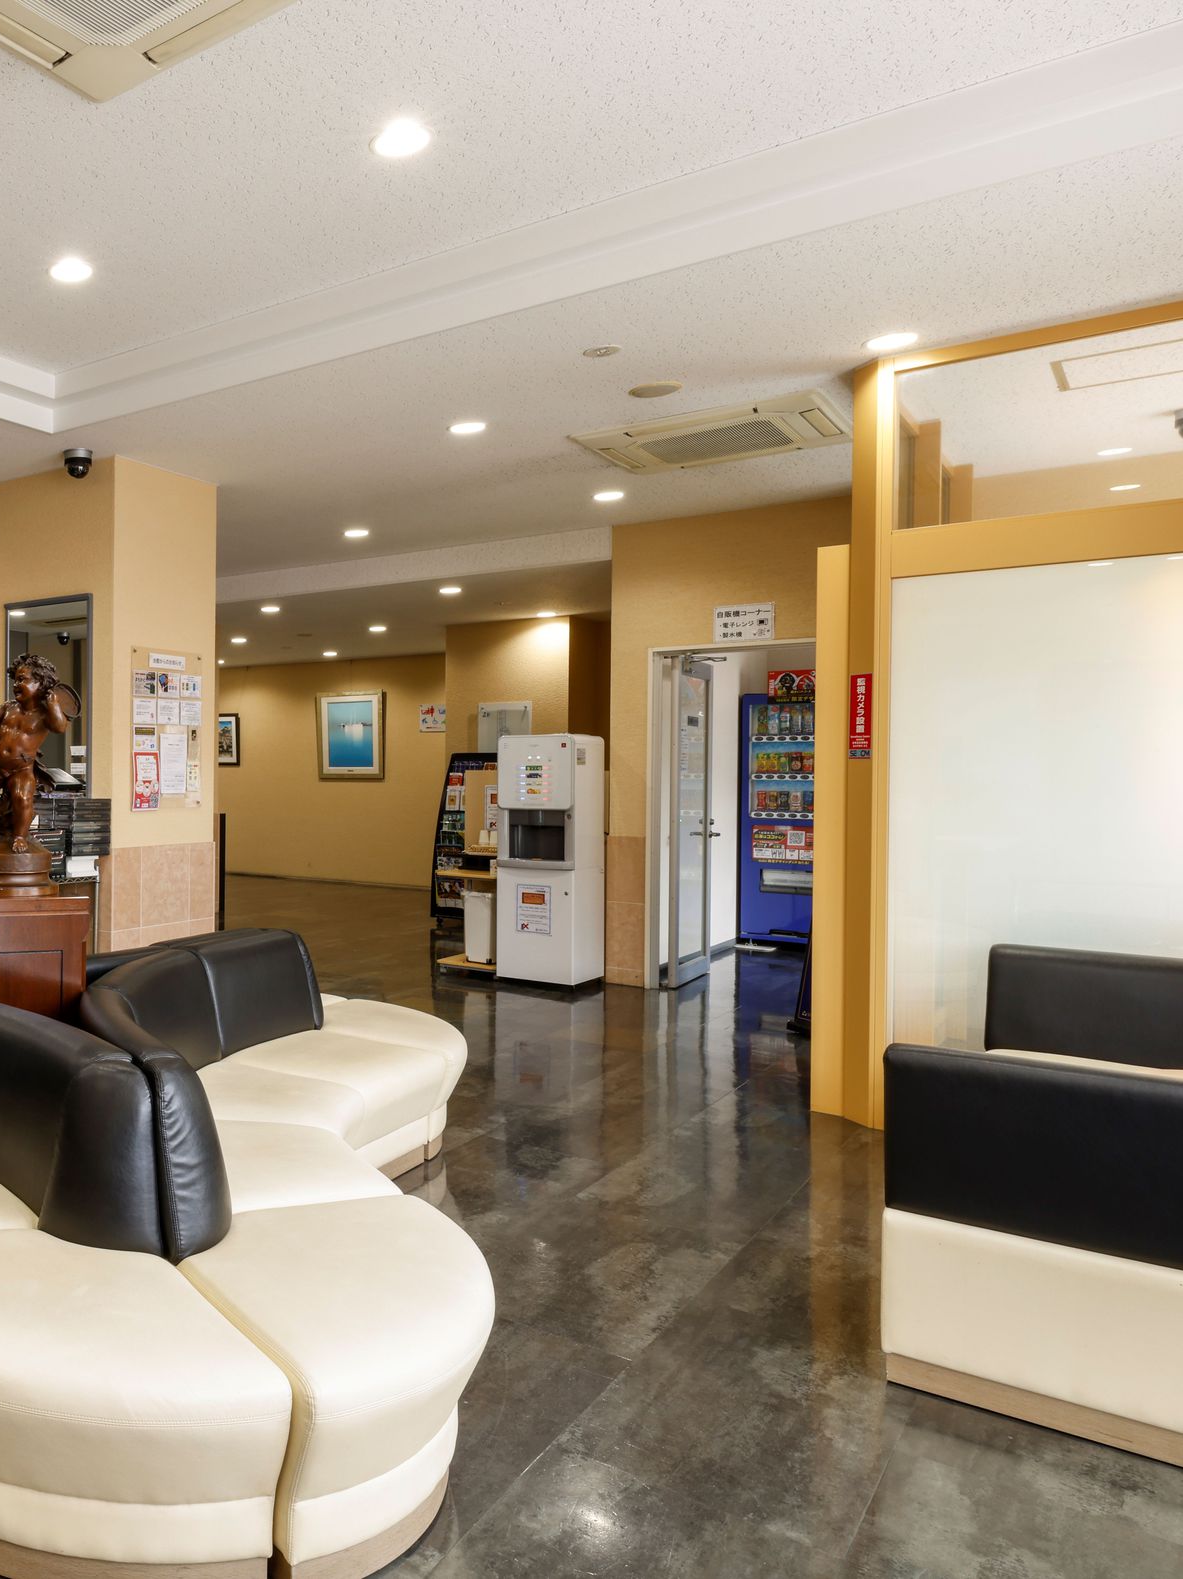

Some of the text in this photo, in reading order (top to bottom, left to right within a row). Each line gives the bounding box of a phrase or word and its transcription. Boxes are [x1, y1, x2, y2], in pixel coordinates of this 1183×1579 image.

[717, 608, 771, 619] 自販機コーナー
